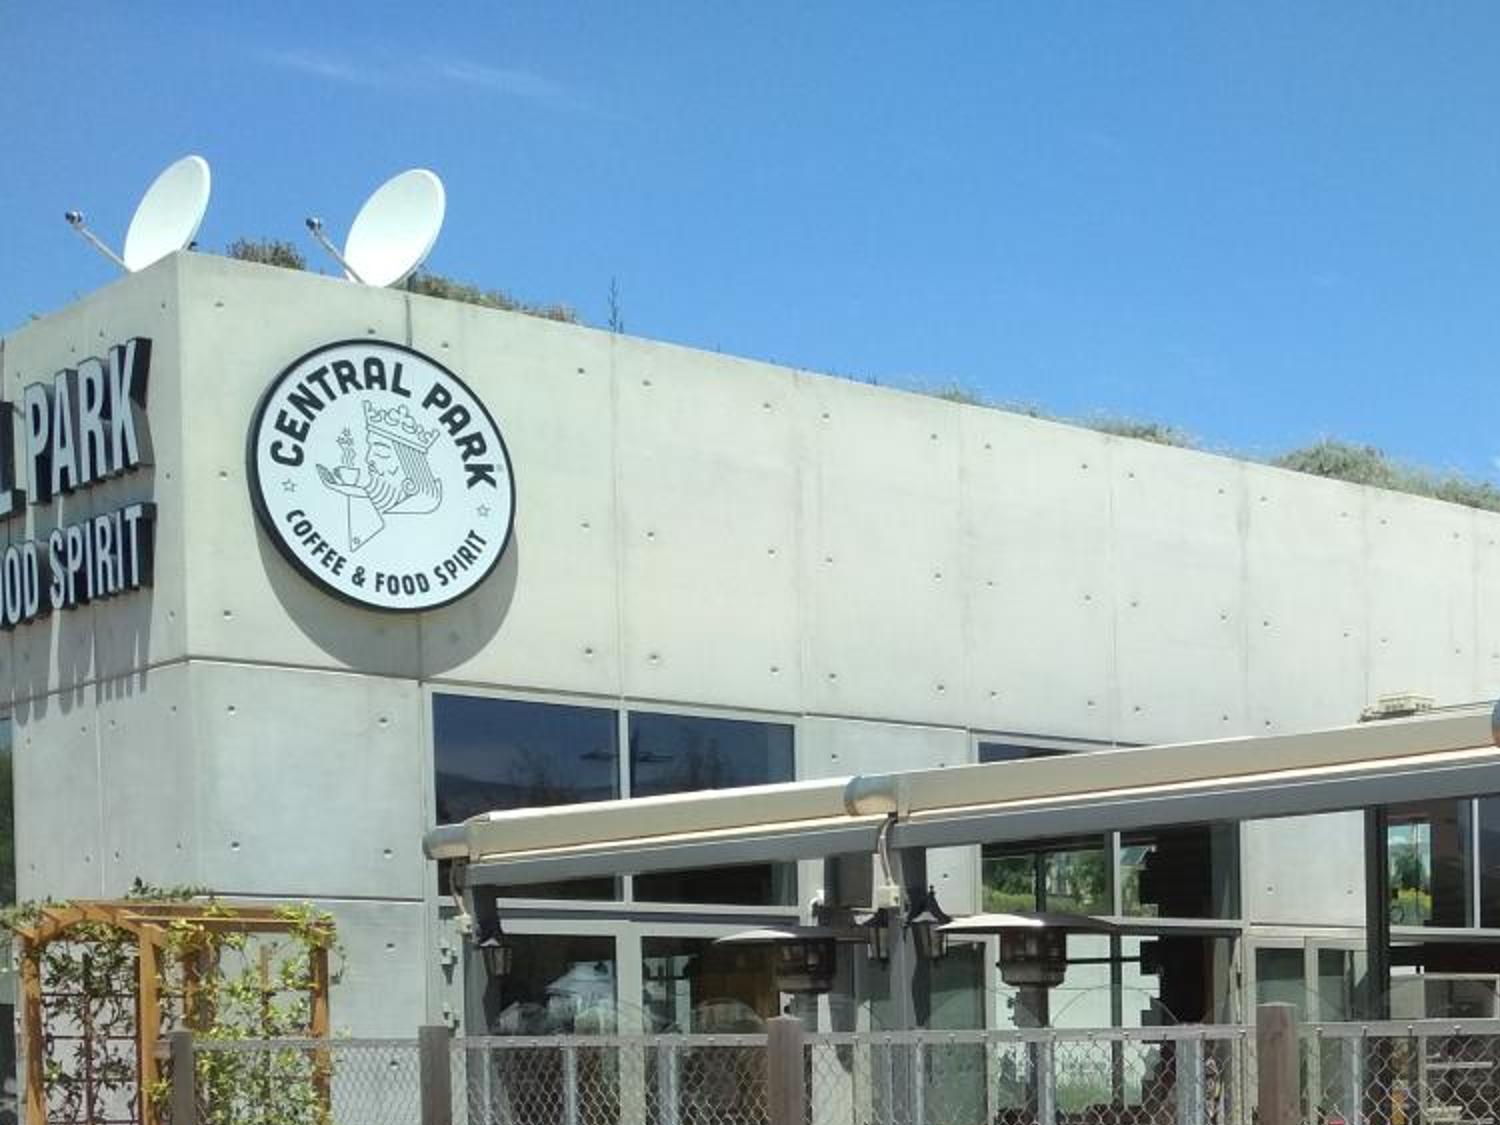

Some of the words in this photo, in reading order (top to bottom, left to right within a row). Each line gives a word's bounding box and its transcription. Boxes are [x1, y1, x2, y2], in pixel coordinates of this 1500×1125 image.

[24, 337, 150, 504] PARK
[269, 357, 411, 467] CENTRAL
[422, 382, 497, 489] PARK
[50, 503, 150, 610] SPIRIT
[285, 509, 347, 576] COFFEE
[351, 566, 367, 588] &
[375, 572, 430, 596] FOOD
[433, 529, 488, 586] SPIRIT
